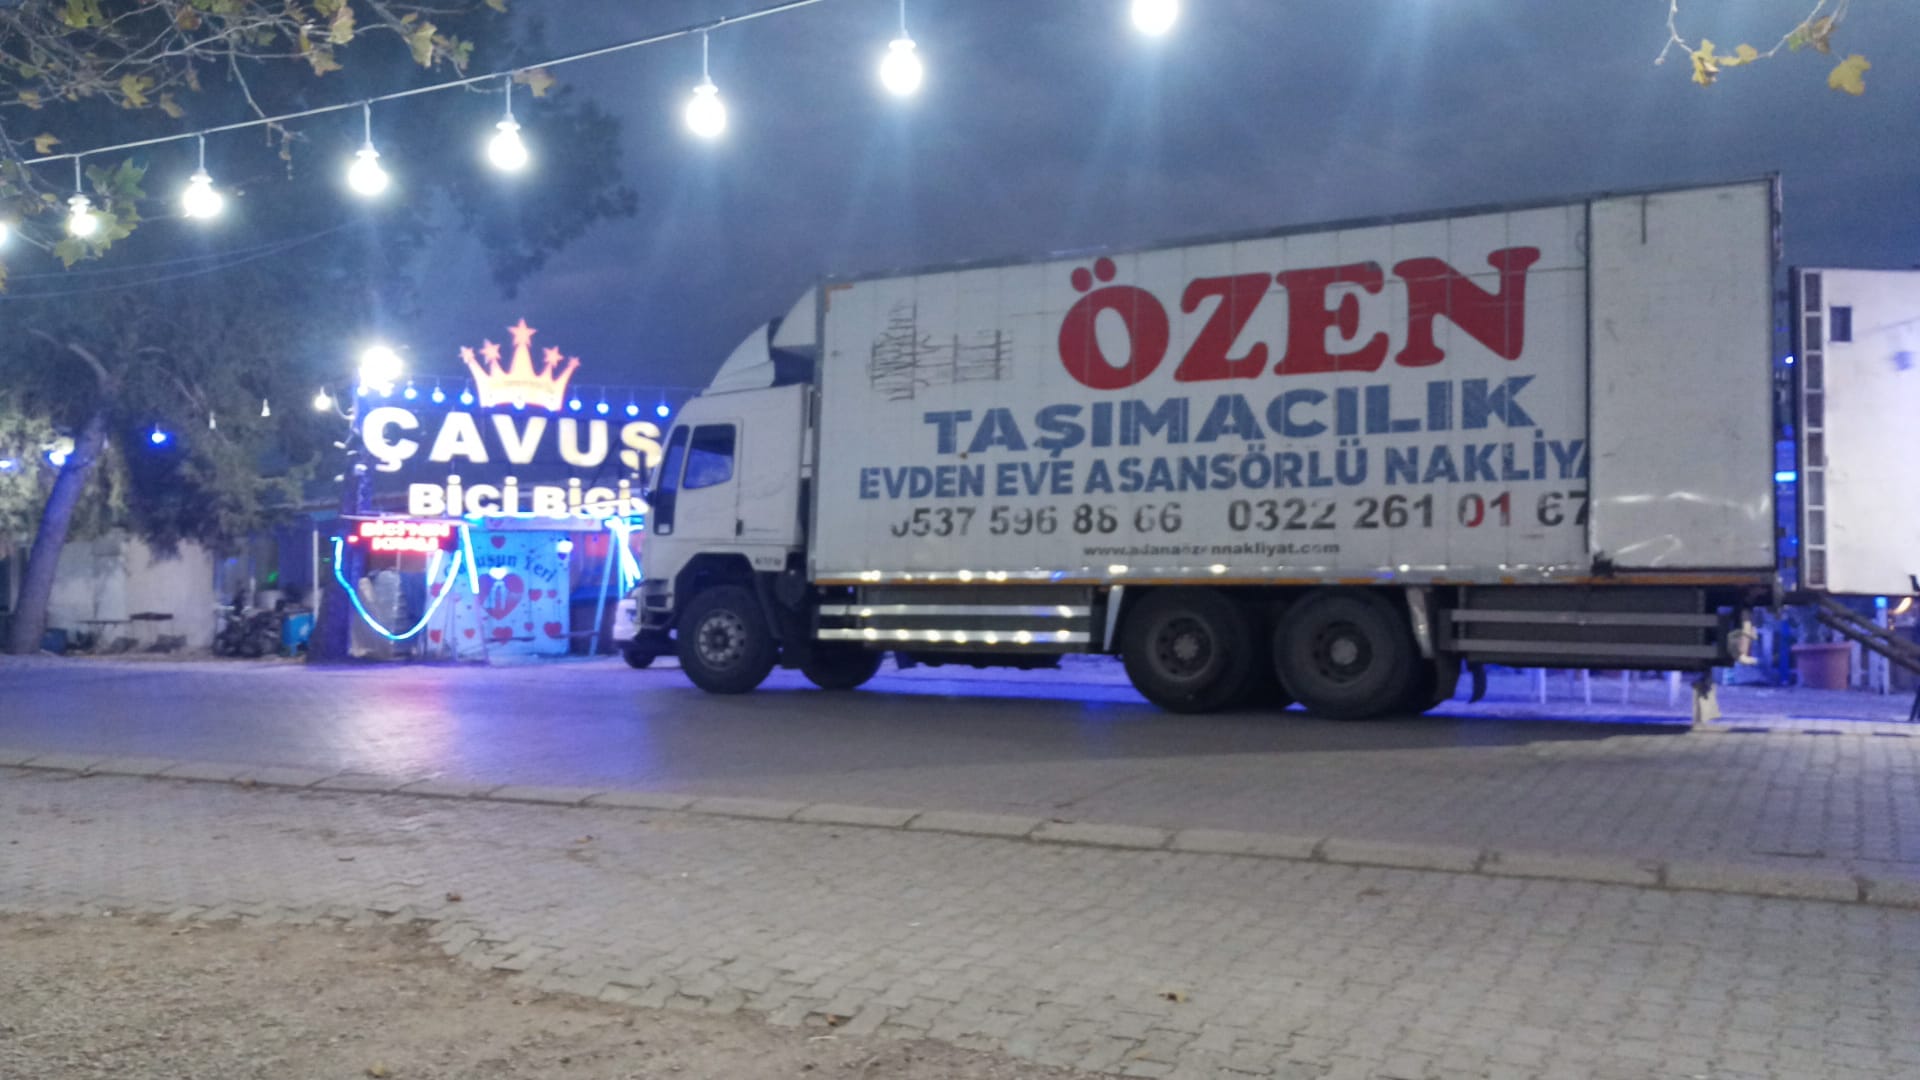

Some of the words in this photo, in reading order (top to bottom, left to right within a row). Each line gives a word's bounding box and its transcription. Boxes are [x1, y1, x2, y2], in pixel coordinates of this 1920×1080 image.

[1058, 246, 1541, 391] ÖZEN
[923, 374, 1537, 458] TAŞIMACILIK
[859, 464, 986, 499] EVDEN
[996, 460, 1075, 497] EVE
[1083, 438, 1368, 494] ASANSÖRLÜ
[989, 504, 1058, 536] 596
[1227, 499, 1337, 533] 0322
[1353, 493, 1434, 530] 261
[1457, 491, 1512, 528] 01
